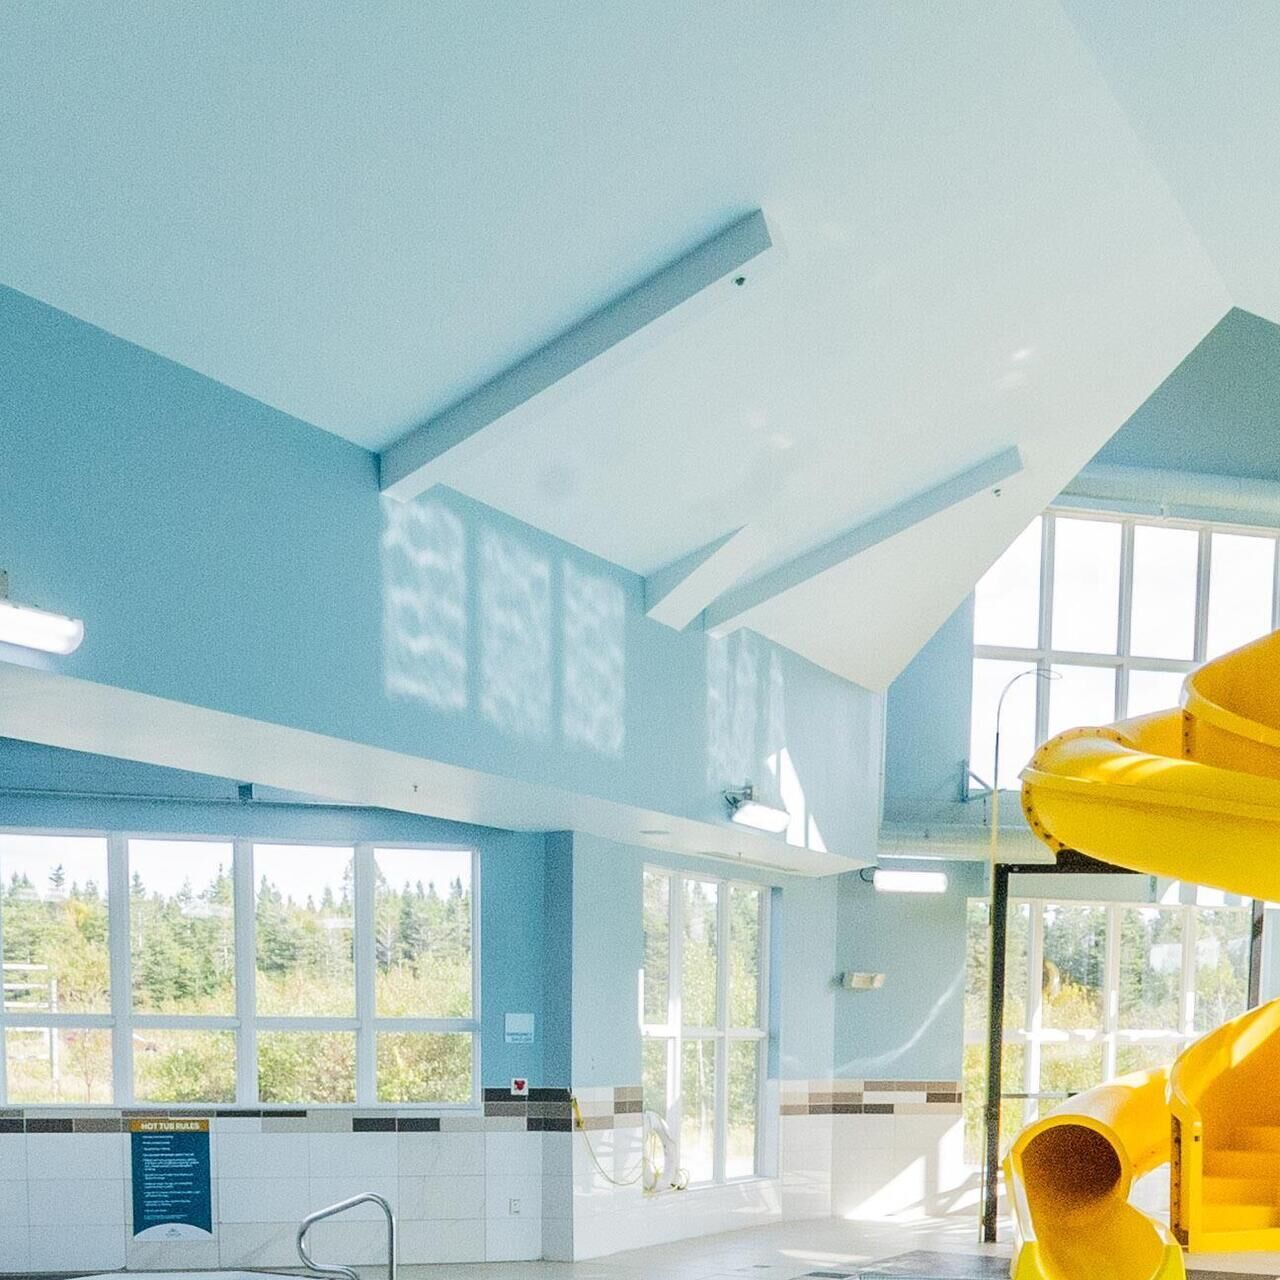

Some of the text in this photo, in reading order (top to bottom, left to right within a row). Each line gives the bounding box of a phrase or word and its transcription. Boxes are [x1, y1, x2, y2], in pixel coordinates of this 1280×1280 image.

[141, 1122, 200, 1130] HOT TUB RULES
